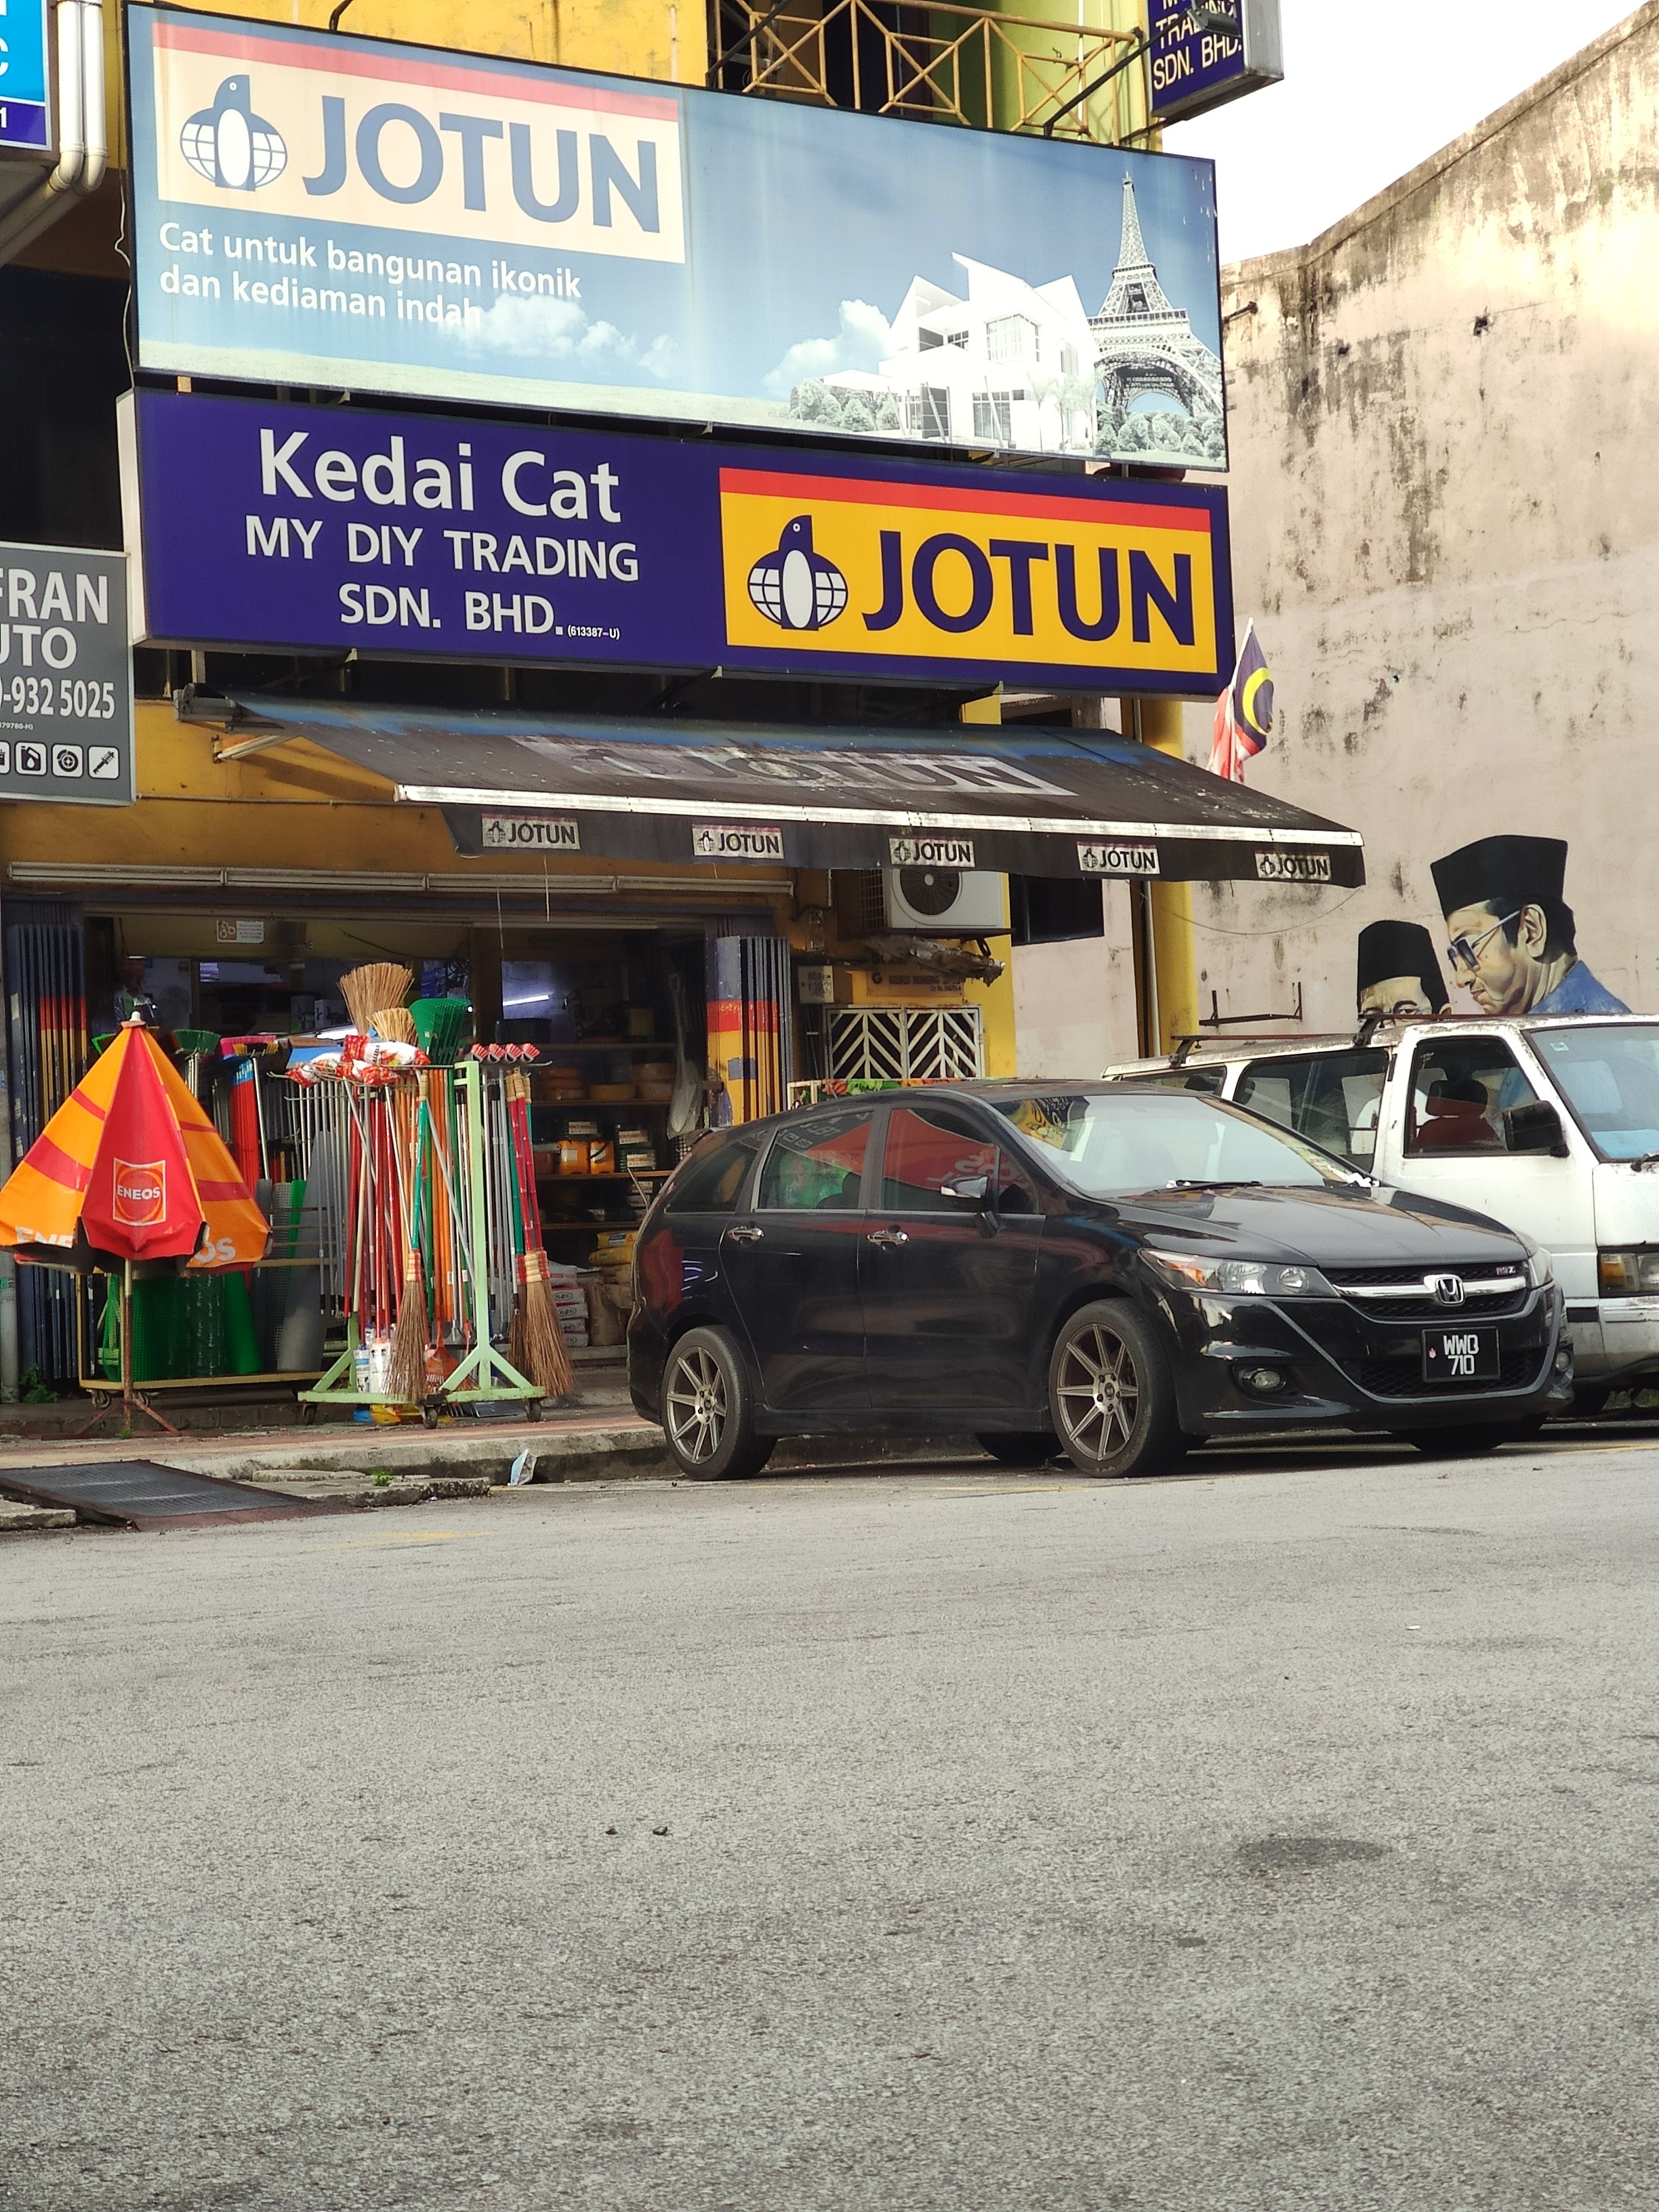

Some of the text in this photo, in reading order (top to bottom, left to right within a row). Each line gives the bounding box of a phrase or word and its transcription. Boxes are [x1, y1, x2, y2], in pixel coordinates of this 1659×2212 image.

[1153, 34, 1242, 90] SDN. BHD.
[302, 95, 660, 233] JOTUN
[159, 222, 581, 298] Cat untuk bangunan ikonik
[160, 264, 481, 328] dan kediaman indah
[260, 428, 621, 523] Kedai Cat
[245, 515, 639, 581] MY DIY TRADING
[0, 567, 108, 625] RAN
[340, 583, 620, 640] SDN. BHD. (613387-U)
[862, 530, 1195, 646] JOTUN
[0, 675, 115, 720] -932 5025
[508, 823, 575, 844] JOTUN
[718, 833, 779, 853] JOTUN
[914, 842, 971, 862] JOTUN
[1100, 850, 1155, 869] JOTUN
[1277, 857, 1328, 876] JOTUN
[117, 1185, 161, 1200] ENEOS
[1448, 1355, 1475, 1375] 710
